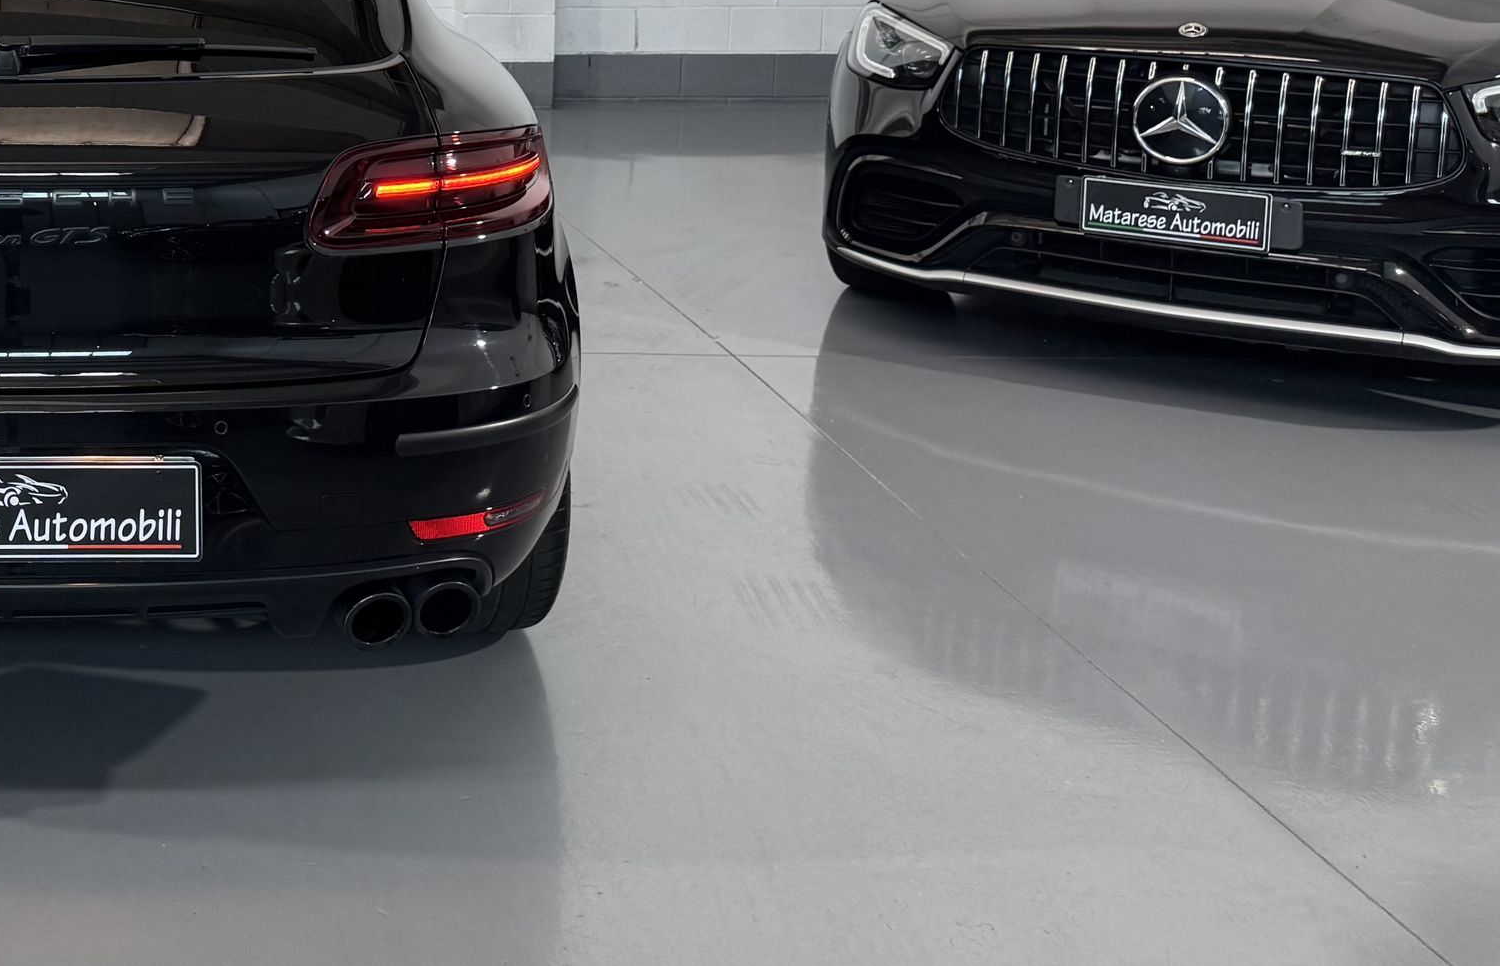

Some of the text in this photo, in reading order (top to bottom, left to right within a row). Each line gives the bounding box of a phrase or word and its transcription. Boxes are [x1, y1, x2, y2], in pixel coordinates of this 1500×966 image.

[30, 226, 110, 245] GTS
[1089, 204, 1260, 240] Matarese Automobili
[9, 509, 181, 541] Automobili
